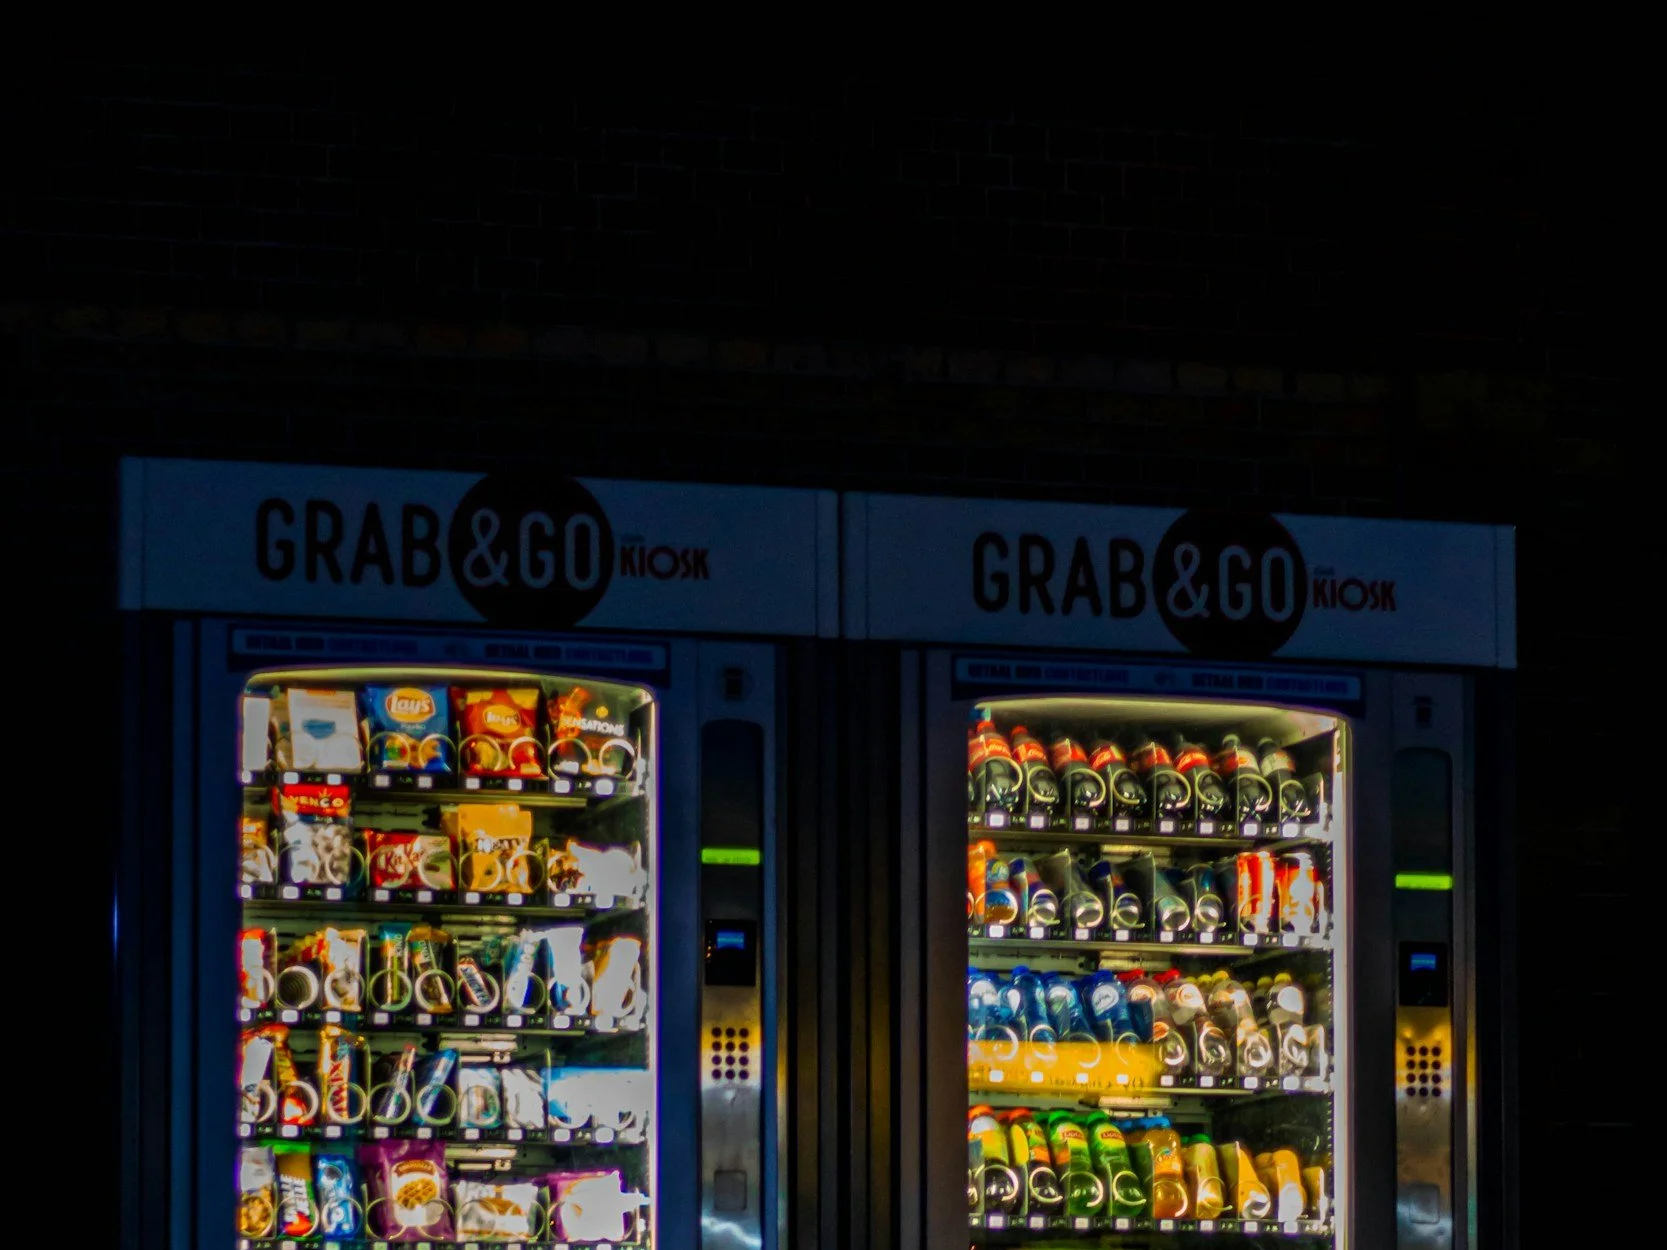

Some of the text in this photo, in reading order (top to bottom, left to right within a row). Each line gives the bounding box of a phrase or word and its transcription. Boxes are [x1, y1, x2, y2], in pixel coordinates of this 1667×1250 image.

[256, 499, 441, 587] GRAB
[621, 544, 710, 581] KIOSK
[972, 532, 1146, 619] GRAB
[1313, 577, 1397, 612] KIOSK
